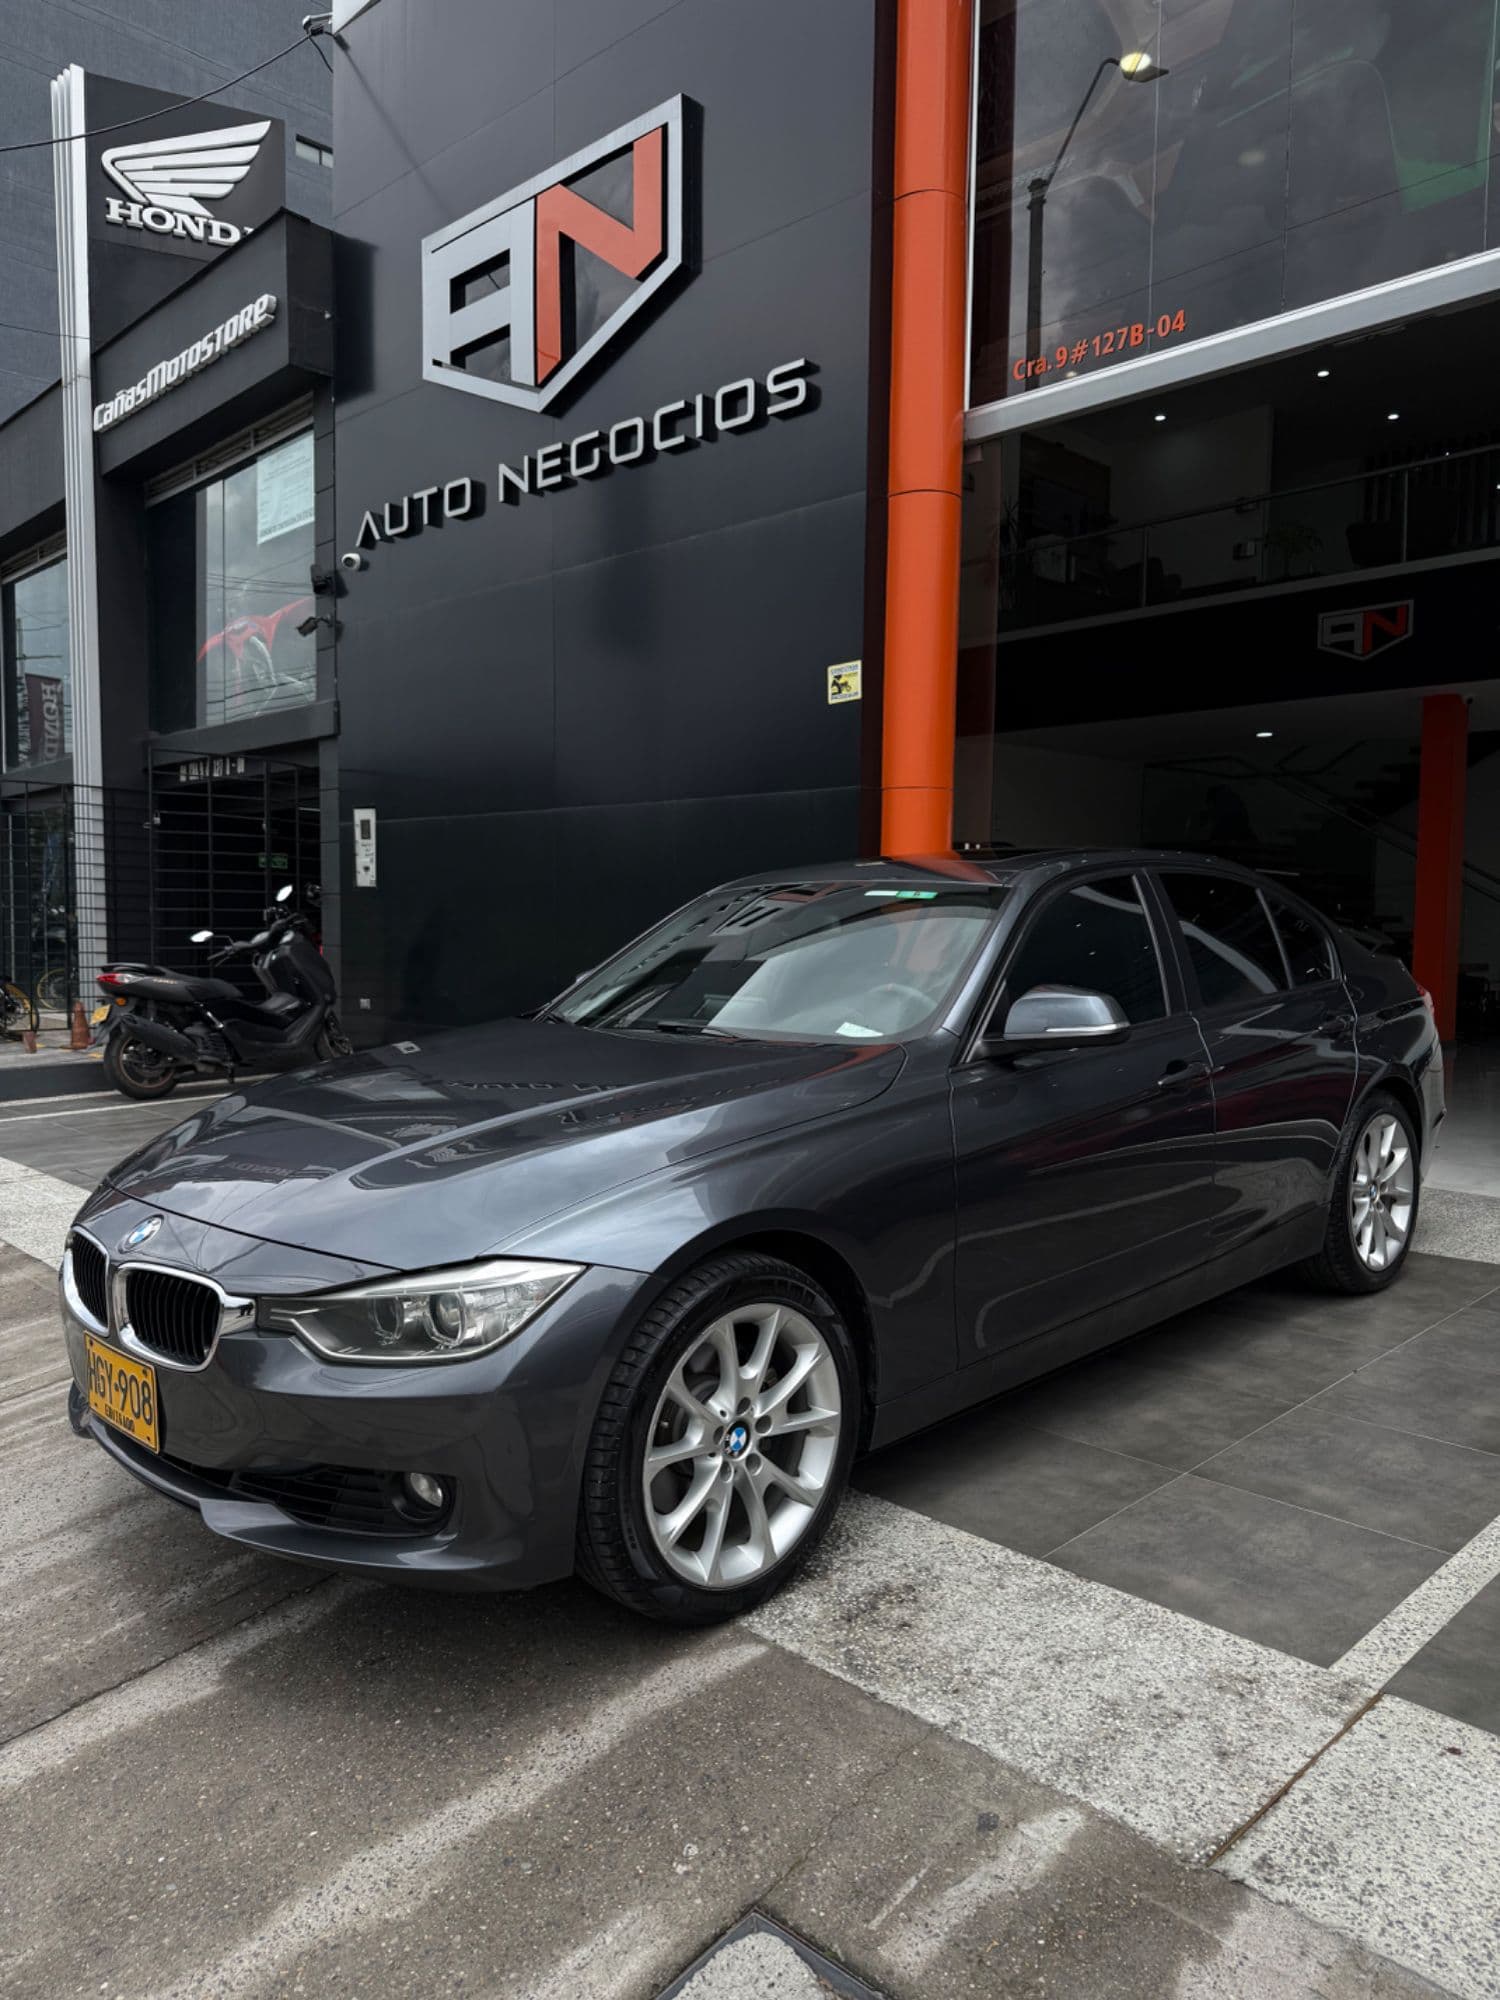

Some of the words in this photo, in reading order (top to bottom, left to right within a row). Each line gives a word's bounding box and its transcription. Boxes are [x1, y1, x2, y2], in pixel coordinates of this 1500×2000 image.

[105, 197, 255, 247] HOND
[356, 477, 472, 547] AUTO
[498, 357, 808, 502] NEGOCIOS
